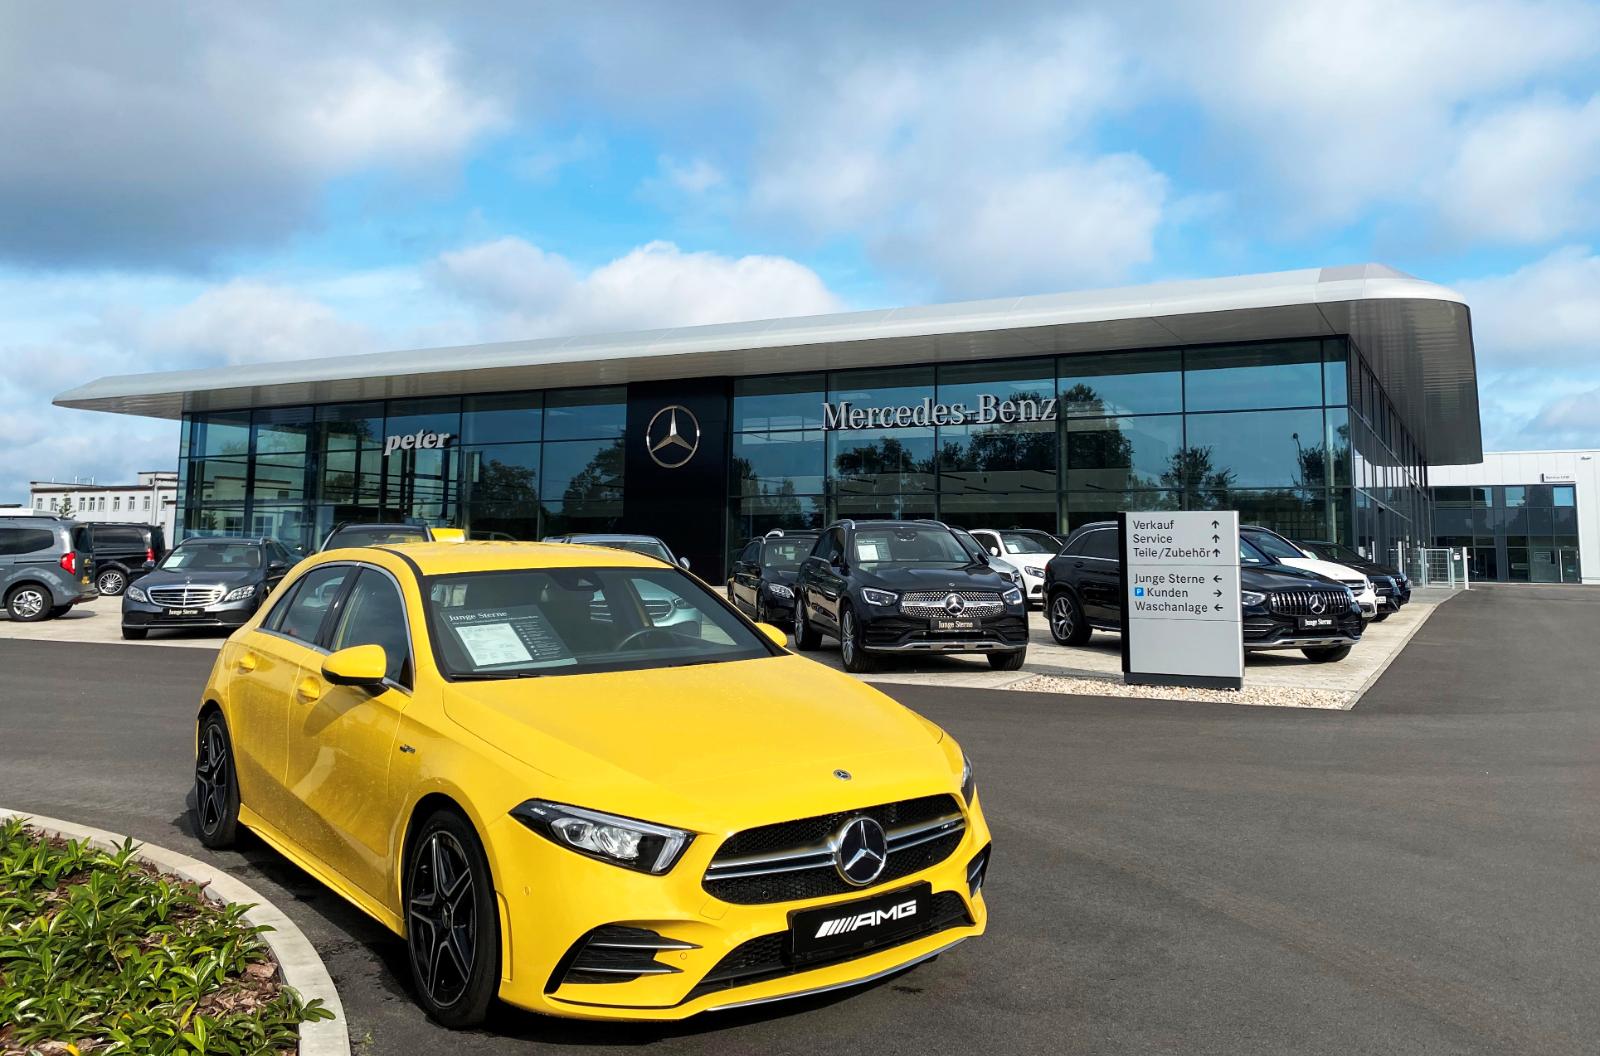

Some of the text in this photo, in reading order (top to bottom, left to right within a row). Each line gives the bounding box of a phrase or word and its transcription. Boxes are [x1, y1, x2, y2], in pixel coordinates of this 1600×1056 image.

[821, 394, 1057, 430] Mercedes-Benz
[383, 428, 450, 456] peter
[1133, 520, 1174, 530] Verkauf
[1133, 534, 1173, 544] Service
[1133, 548, 1211, 559] Teile/Zubehör
[1135, 573, 1205, 585] Junge Sterne
[1147, 588, 1188, 598] Kunden
[1135, 602, 1208, 614] Waschanlage
